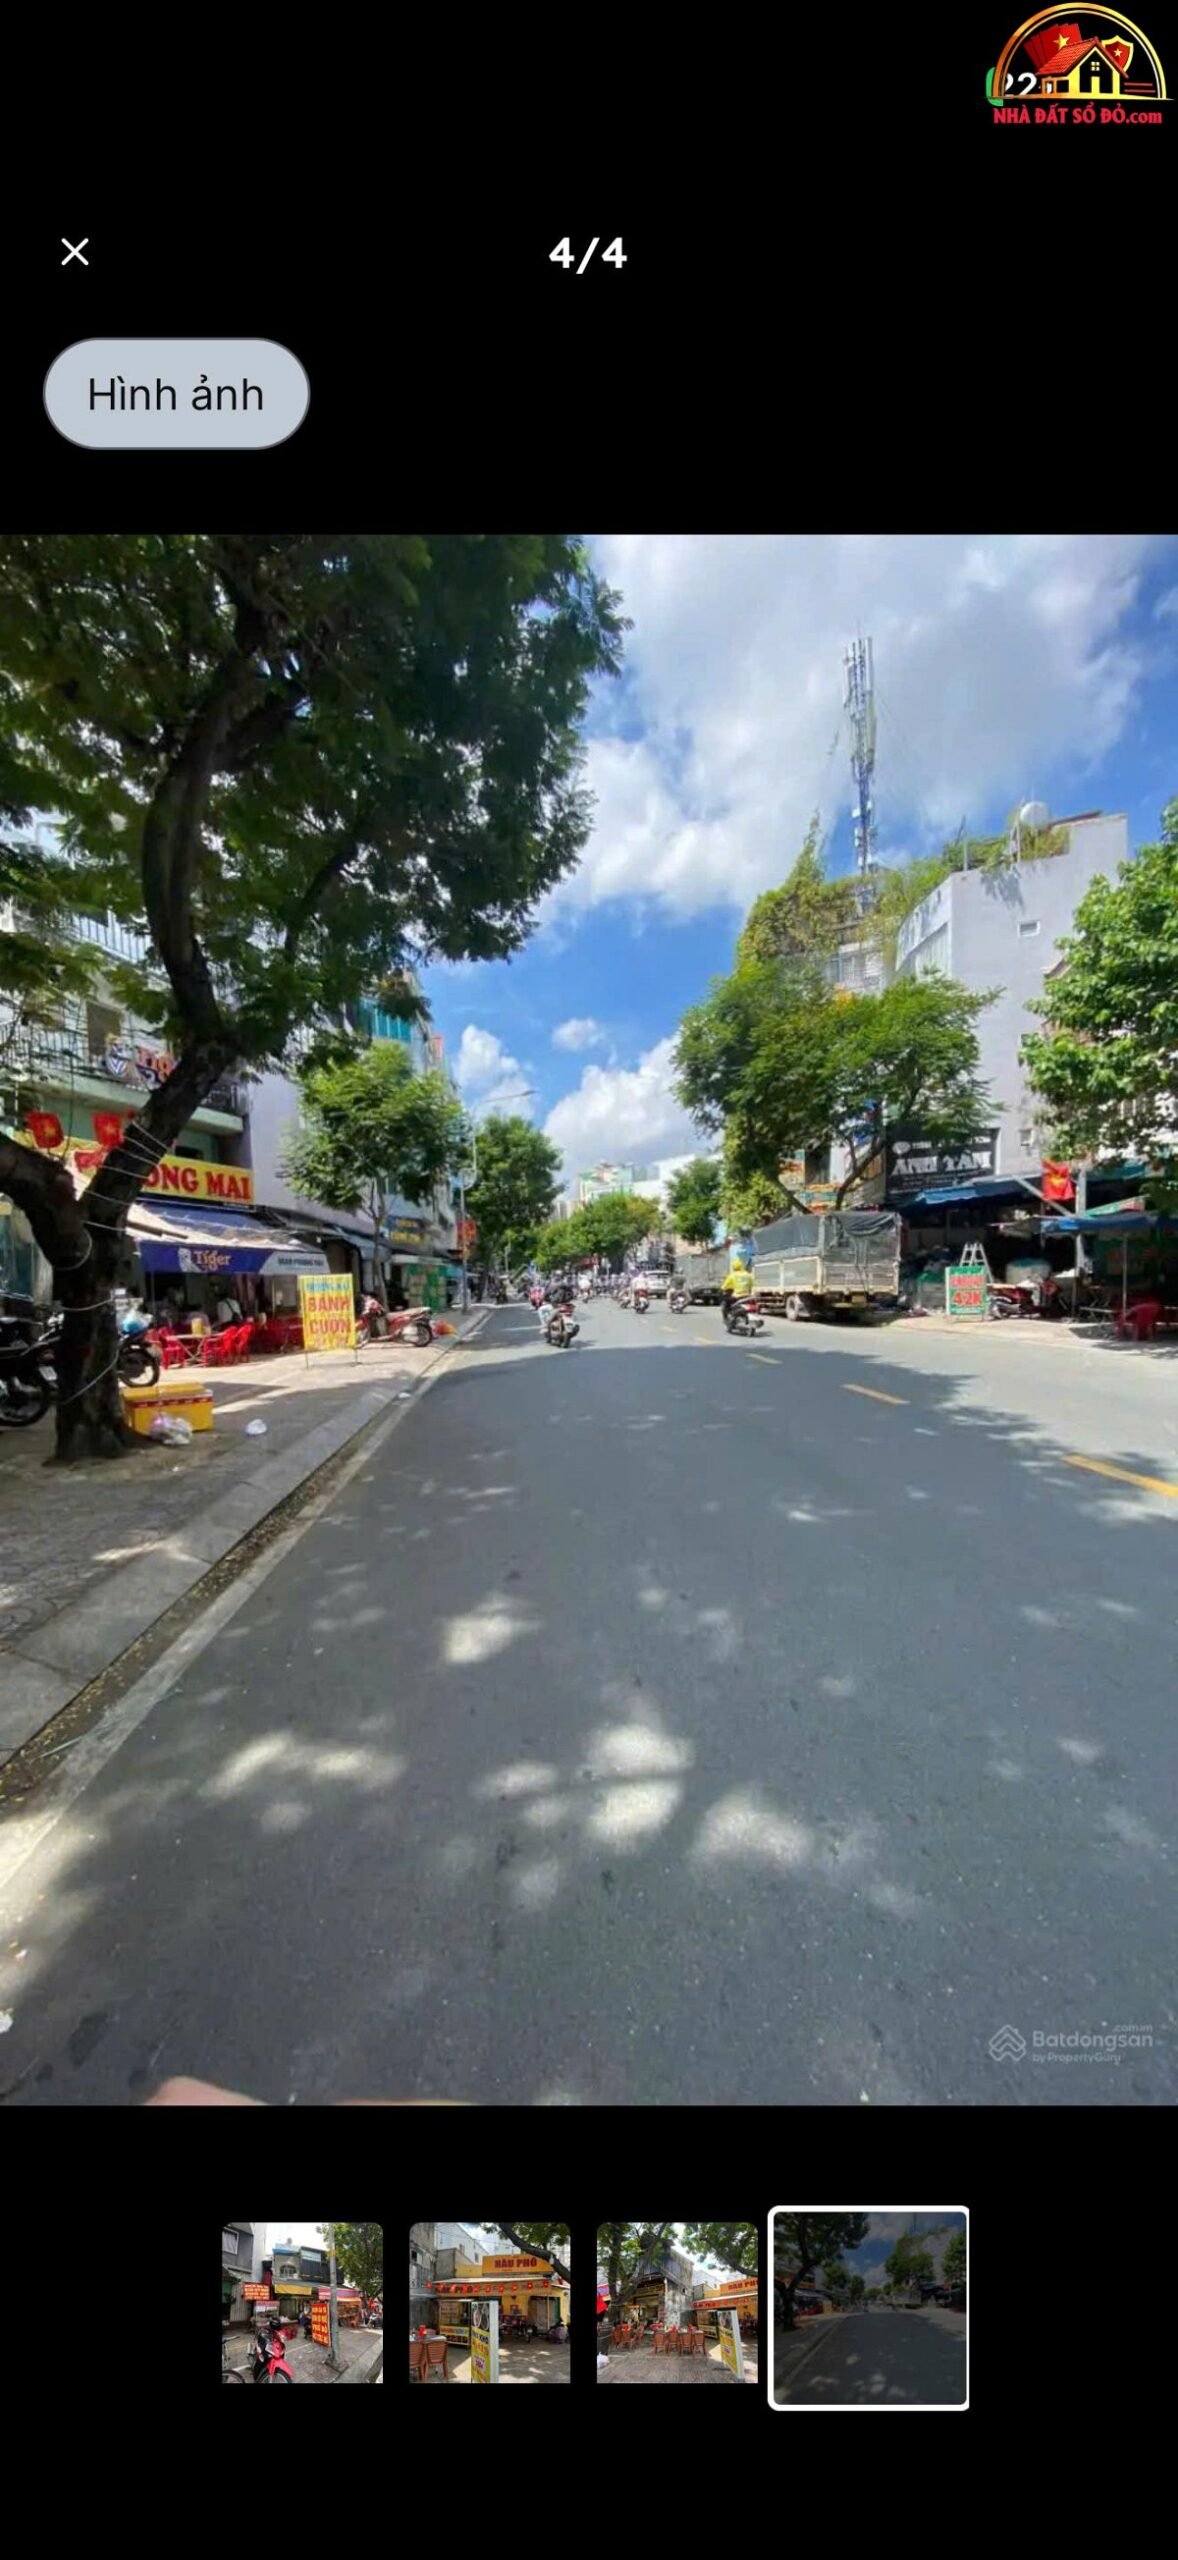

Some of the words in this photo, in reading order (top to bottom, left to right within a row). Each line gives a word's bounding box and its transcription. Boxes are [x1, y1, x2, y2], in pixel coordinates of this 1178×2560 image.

[548, 237, 628, 274] 4/4
[89, 376, 177, 411] Hình
[190, 374, 264, 411] ảnh
[205, 1171, 251, 1200] MAI
[193, 1250, 232, 1271] Tiger
